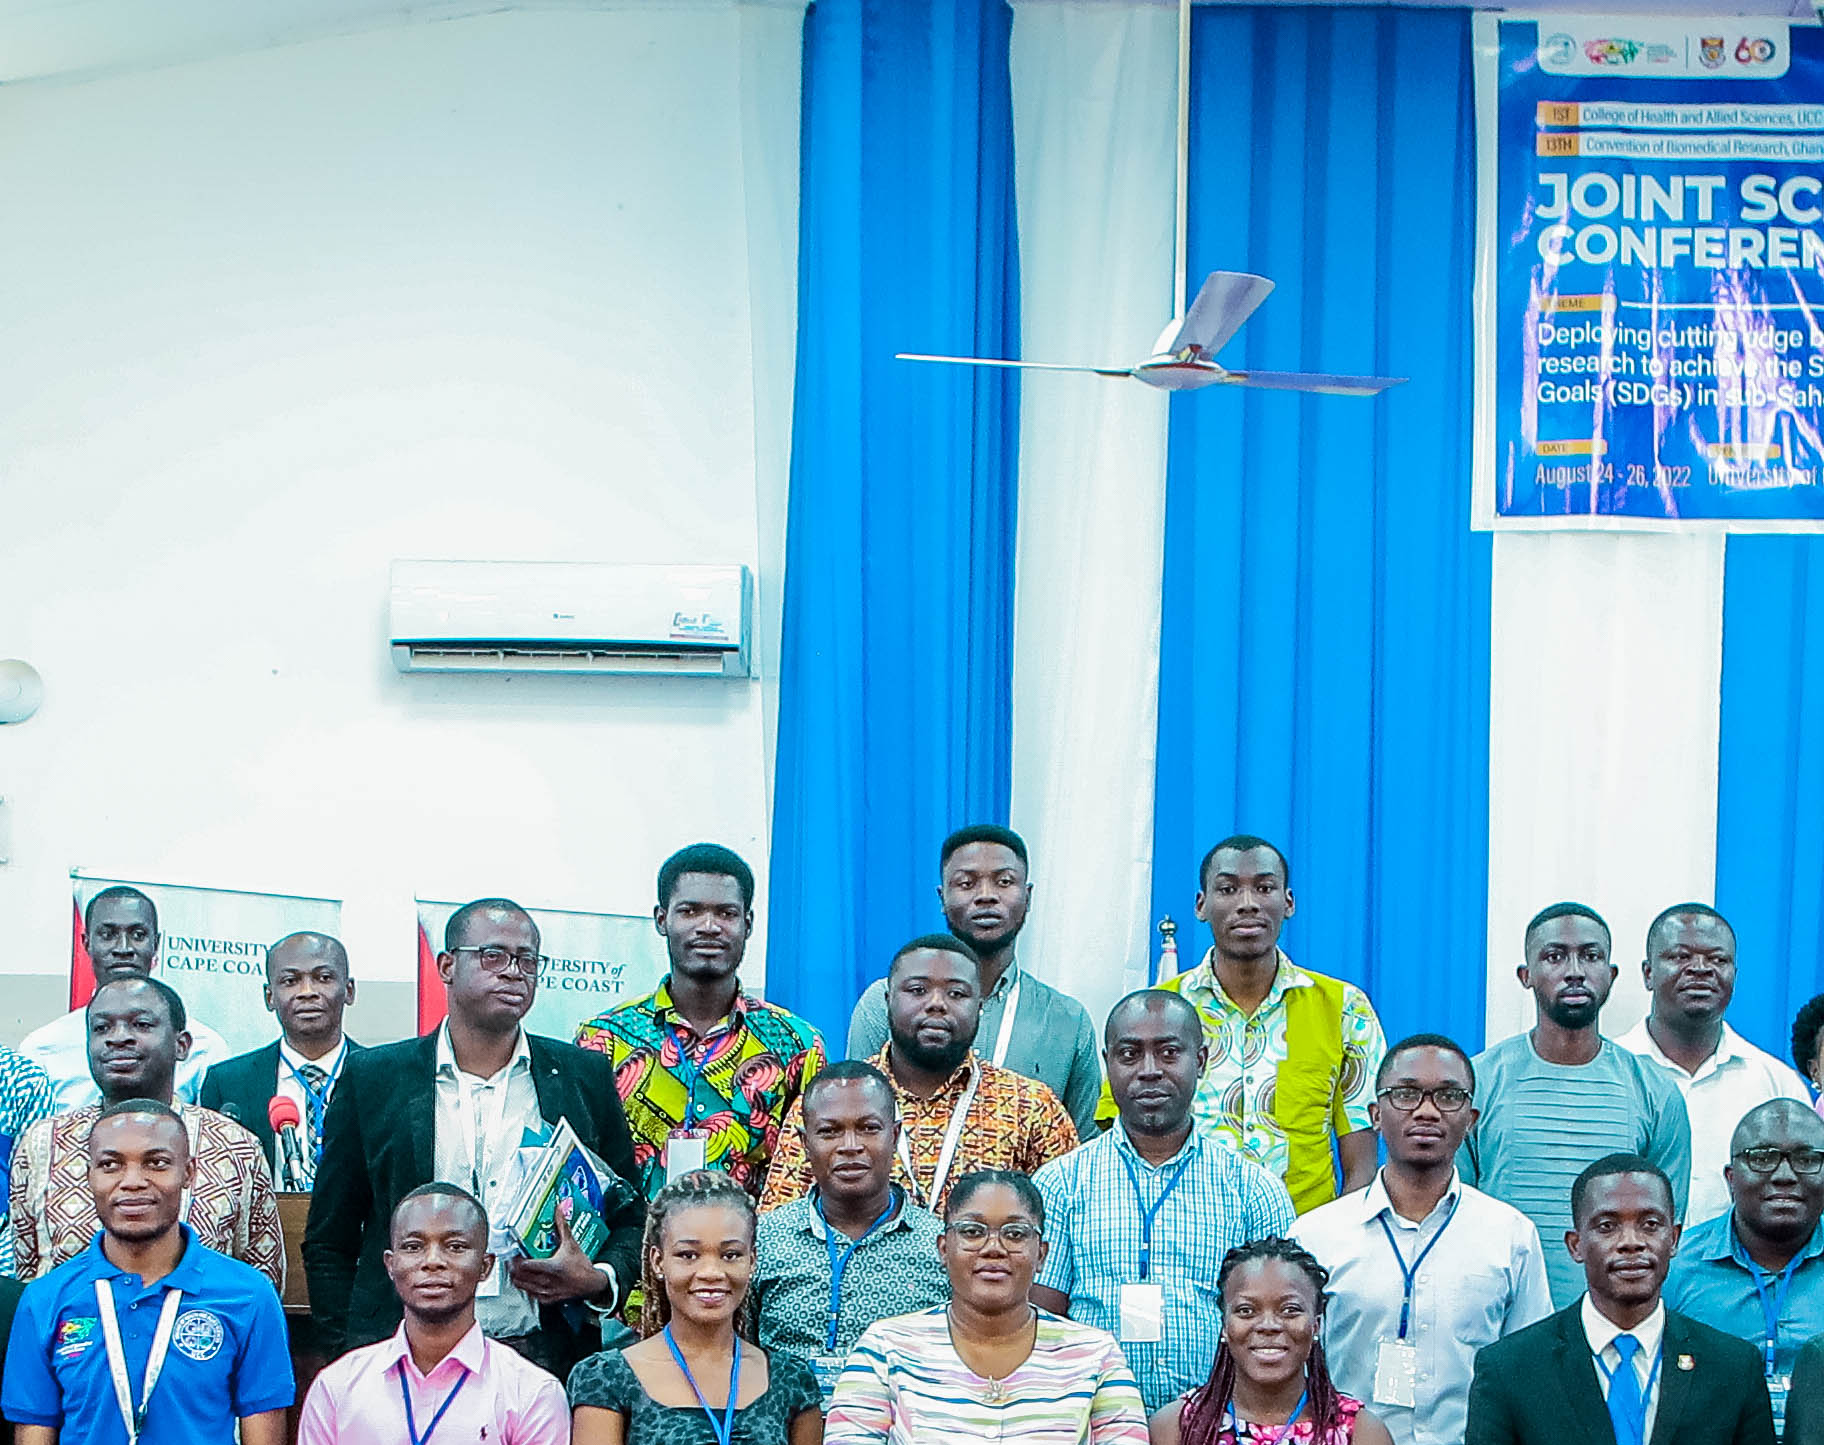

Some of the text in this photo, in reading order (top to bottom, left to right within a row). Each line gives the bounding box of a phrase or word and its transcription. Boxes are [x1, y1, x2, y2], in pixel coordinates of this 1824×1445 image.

[1583, 107, 1625, 125] College
[1627, 108, 1640, 122] of
[1641, 109, 1678, 123] Health
[1679, 110, 1703, 124] and
[1706, 109, 1738, 125] Allied
[1741, 110, 1794, 127] Sciences,
[1798, 111, 1824, 125] UCC
[1546, 137, 1572, 151] 13TH
[1586, 138, 1646, 154] Convention
[1649, 139, 1664, 153] of
[1667, 139, 1734, 155] Biomedical
[1535, 173, 1726, 222] JOINT
[1537, 322, 1651, 351] Deploying
[1658, 324, 1738, 352] cutting
[1537, 351, 1635, 375] research
[1641, 354, 1663, 377] to
[1669, 355, 1758, 379] achieve
[1765, 356, 1803, 379] the
[1537, 381, 1603, 404] Goals
[1609, 382, 1692, 411] (SDGs)
[1698, 384, 1719, 406] in
[1535, 462, 1593, 491] August
[1596, 462, 1614, 484] 24
[1626, 464, 1649, 489] 26,
[1652, 463, 1692, 488] 2022
[1708, 463, 1793, 490] University
[167, 956, 263, 977] CAPE COA
[610, 962, 625, 979] of
[562, 977, 625, 994] COAST
